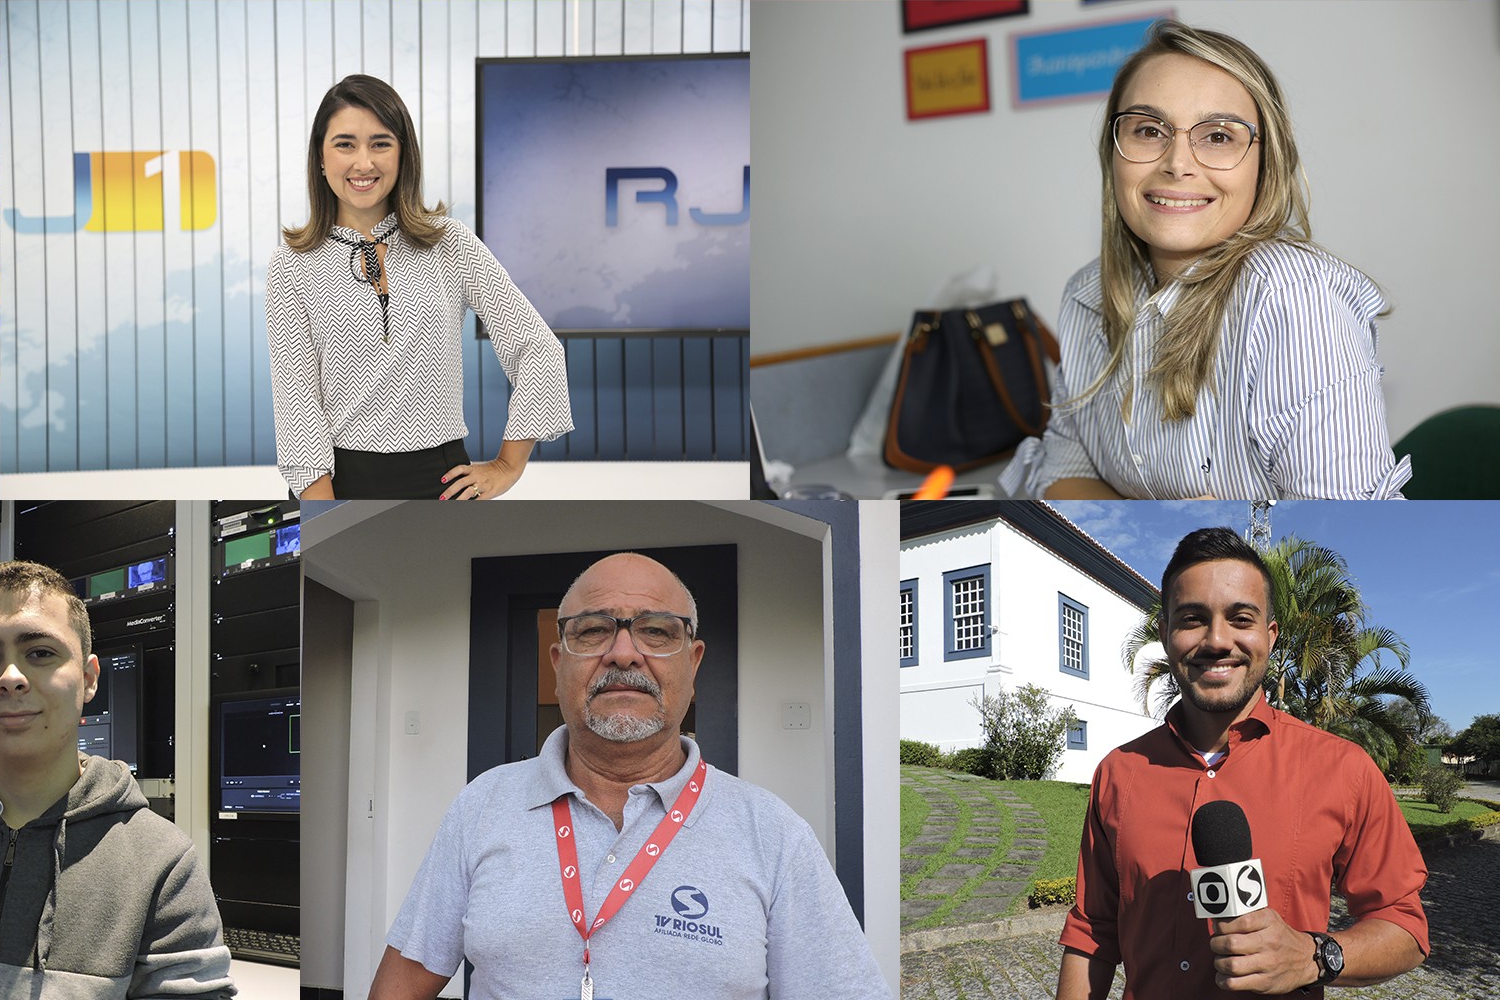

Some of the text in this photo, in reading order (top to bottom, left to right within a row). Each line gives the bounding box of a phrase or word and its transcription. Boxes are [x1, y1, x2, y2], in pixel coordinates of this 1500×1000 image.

[605, 164, 750, 227] RJ
[654, 914, 672, 928] TV
[654, 928, 682, 938] AFILIADA
